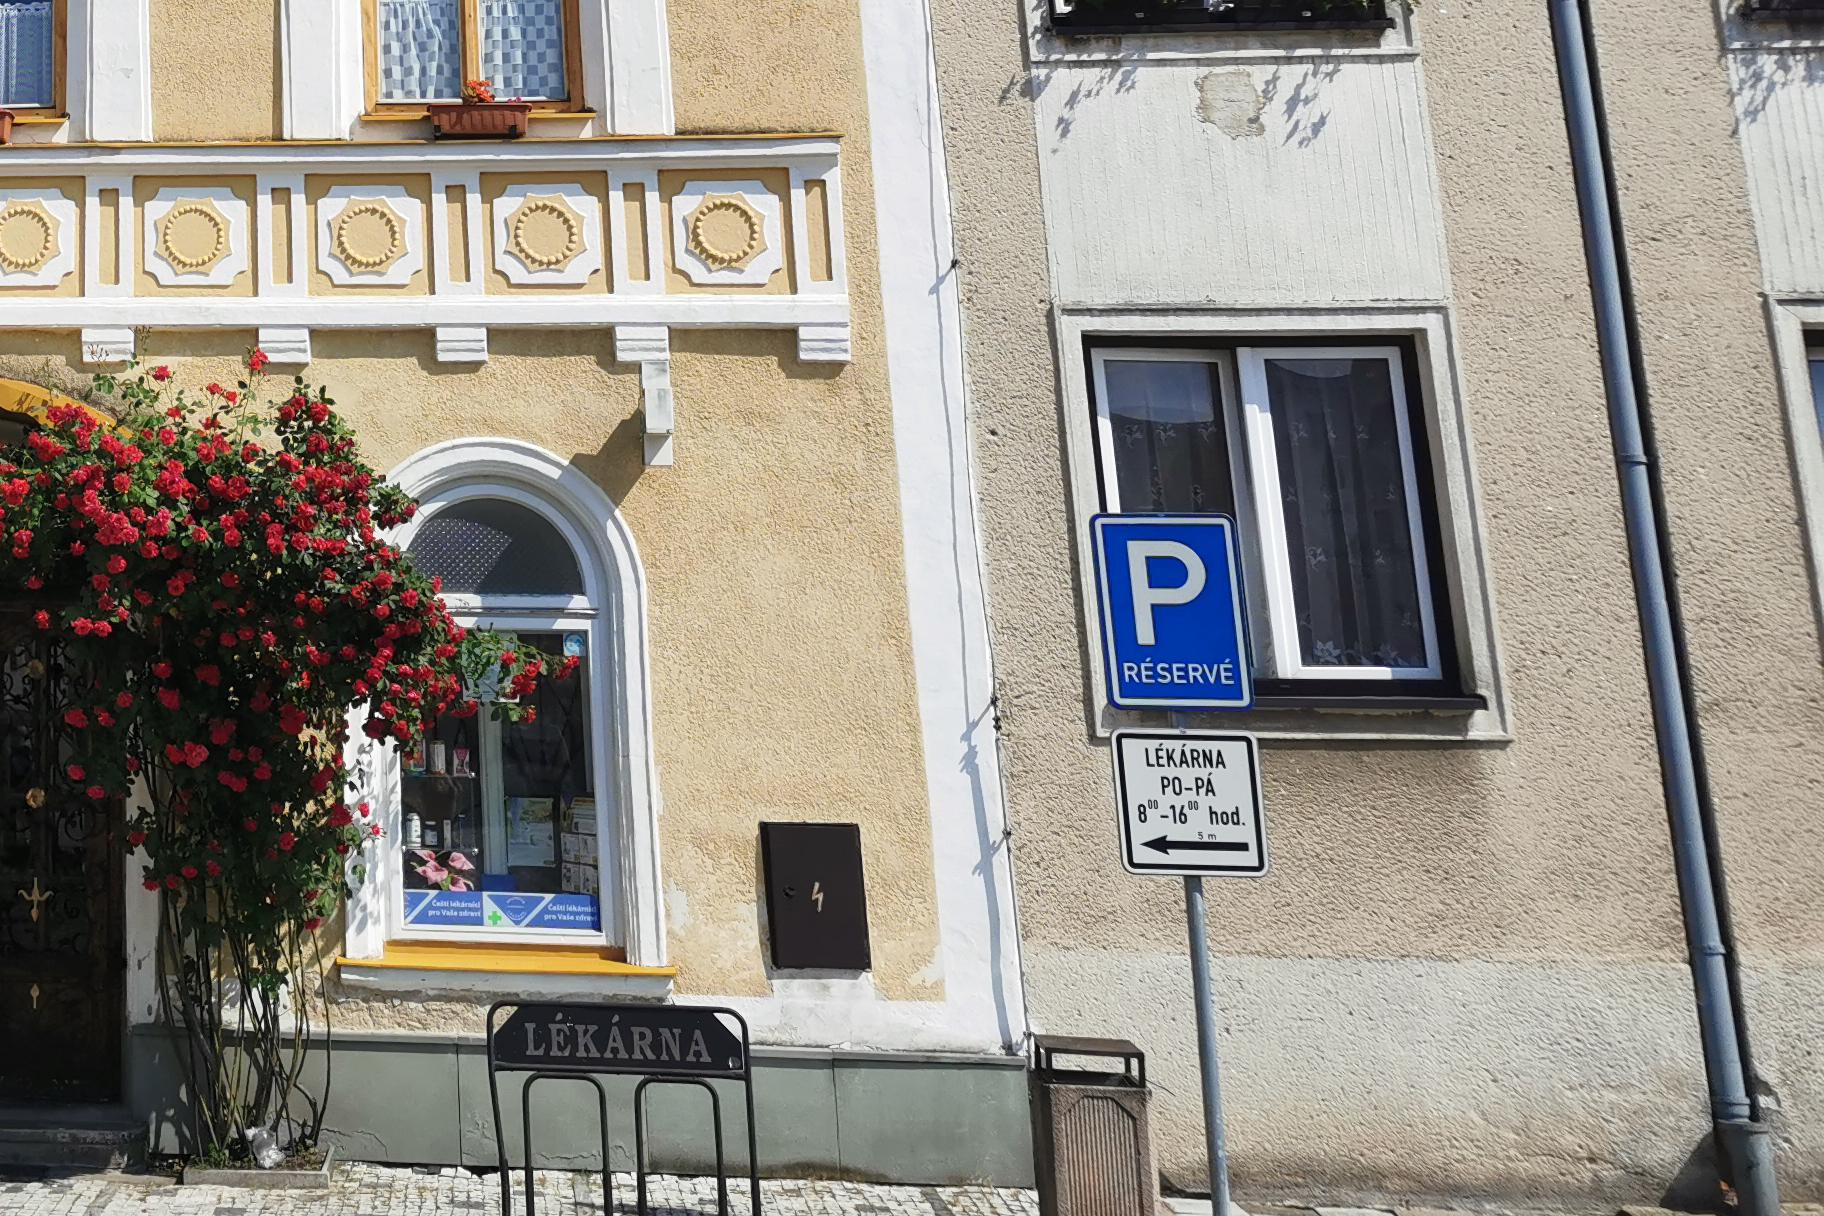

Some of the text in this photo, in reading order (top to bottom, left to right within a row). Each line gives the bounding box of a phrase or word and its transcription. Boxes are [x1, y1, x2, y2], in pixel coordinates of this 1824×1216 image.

[1126, 539, 1207, 646] P
[1122, 657, 1236, 686] RÉSERVÉ
[1144, 742, 1227, 770] LÉKÁRNA
[1160, 772, 1217, 798] PO-PÁ
[1208, 804, 1247, 826] hod.
[1197, 832, 1205, 841] 5
[428, 910, 440, 918] pro
[523, 1012, 713, 1063] LÉKÁRNA
